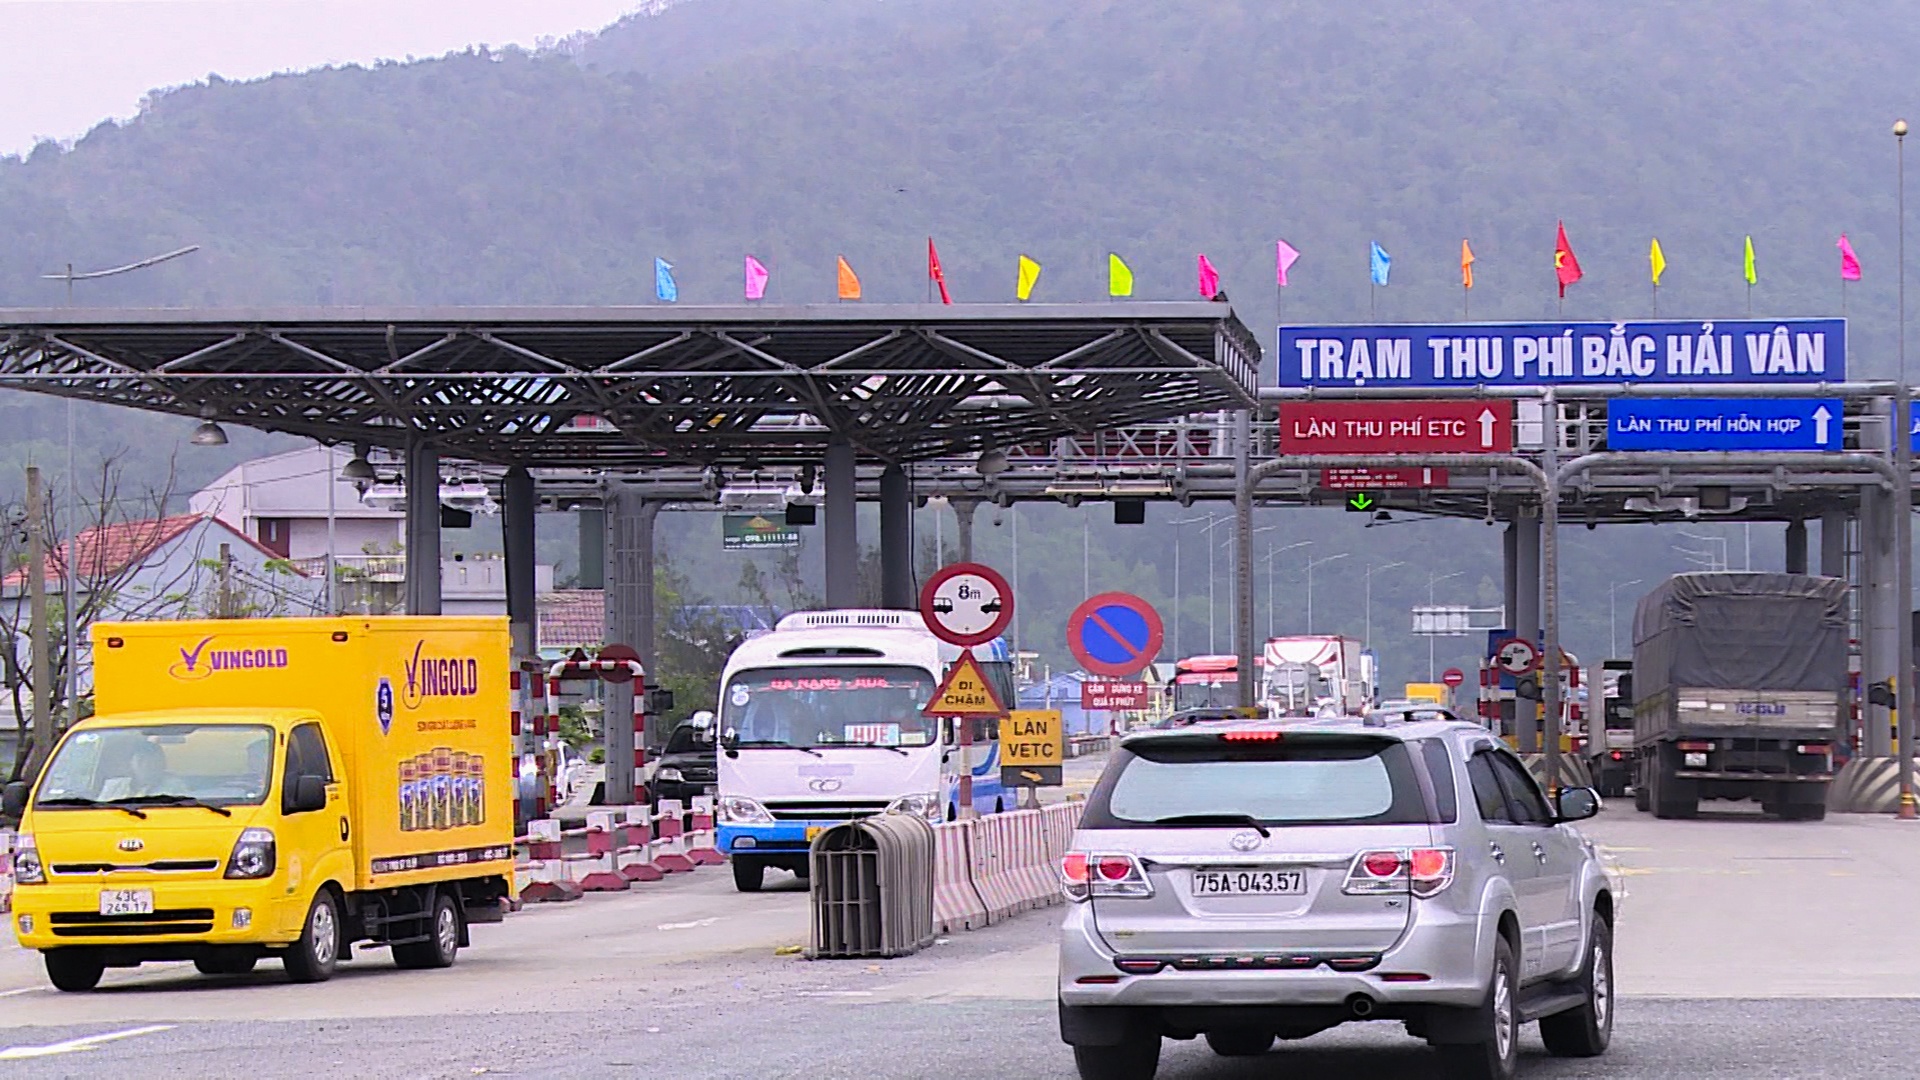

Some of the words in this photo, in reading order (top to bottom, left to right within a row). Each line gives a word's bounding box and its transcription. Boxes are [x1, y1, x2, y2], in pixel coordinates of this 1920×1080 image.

[1296, 338, 1411, 386] TRẠM
[1428, 336, 1502, 379] THU
[1513, 328, 1573, 378] PHÍ
[1666, 322, 1733, 375] HẢI
[1745, 325, 1826, 374] VÂN
[1294, 417, 1336, 438] LÀN
[1344, 420, 1383, 437] THU
[1390, 416, 1422, 437] PHÍ
[1428, 420, 1467, 437] ETC
[1617, 415, 1650, 432] LÀN
[1658, 418, 1690, 432] THU
[1696, 415, 1722, 432] PHÍ
[1767, 418, 1802, 435] HỢP
[958, 585, 981, 600] 8m
[210, 648, 288, 670] VINGOLD
[1014, 718, 1047, 736] LÀN
[1008, 743, 1053, 757] VETC
[1196, 872, 1300, 893] 75A-043.57
